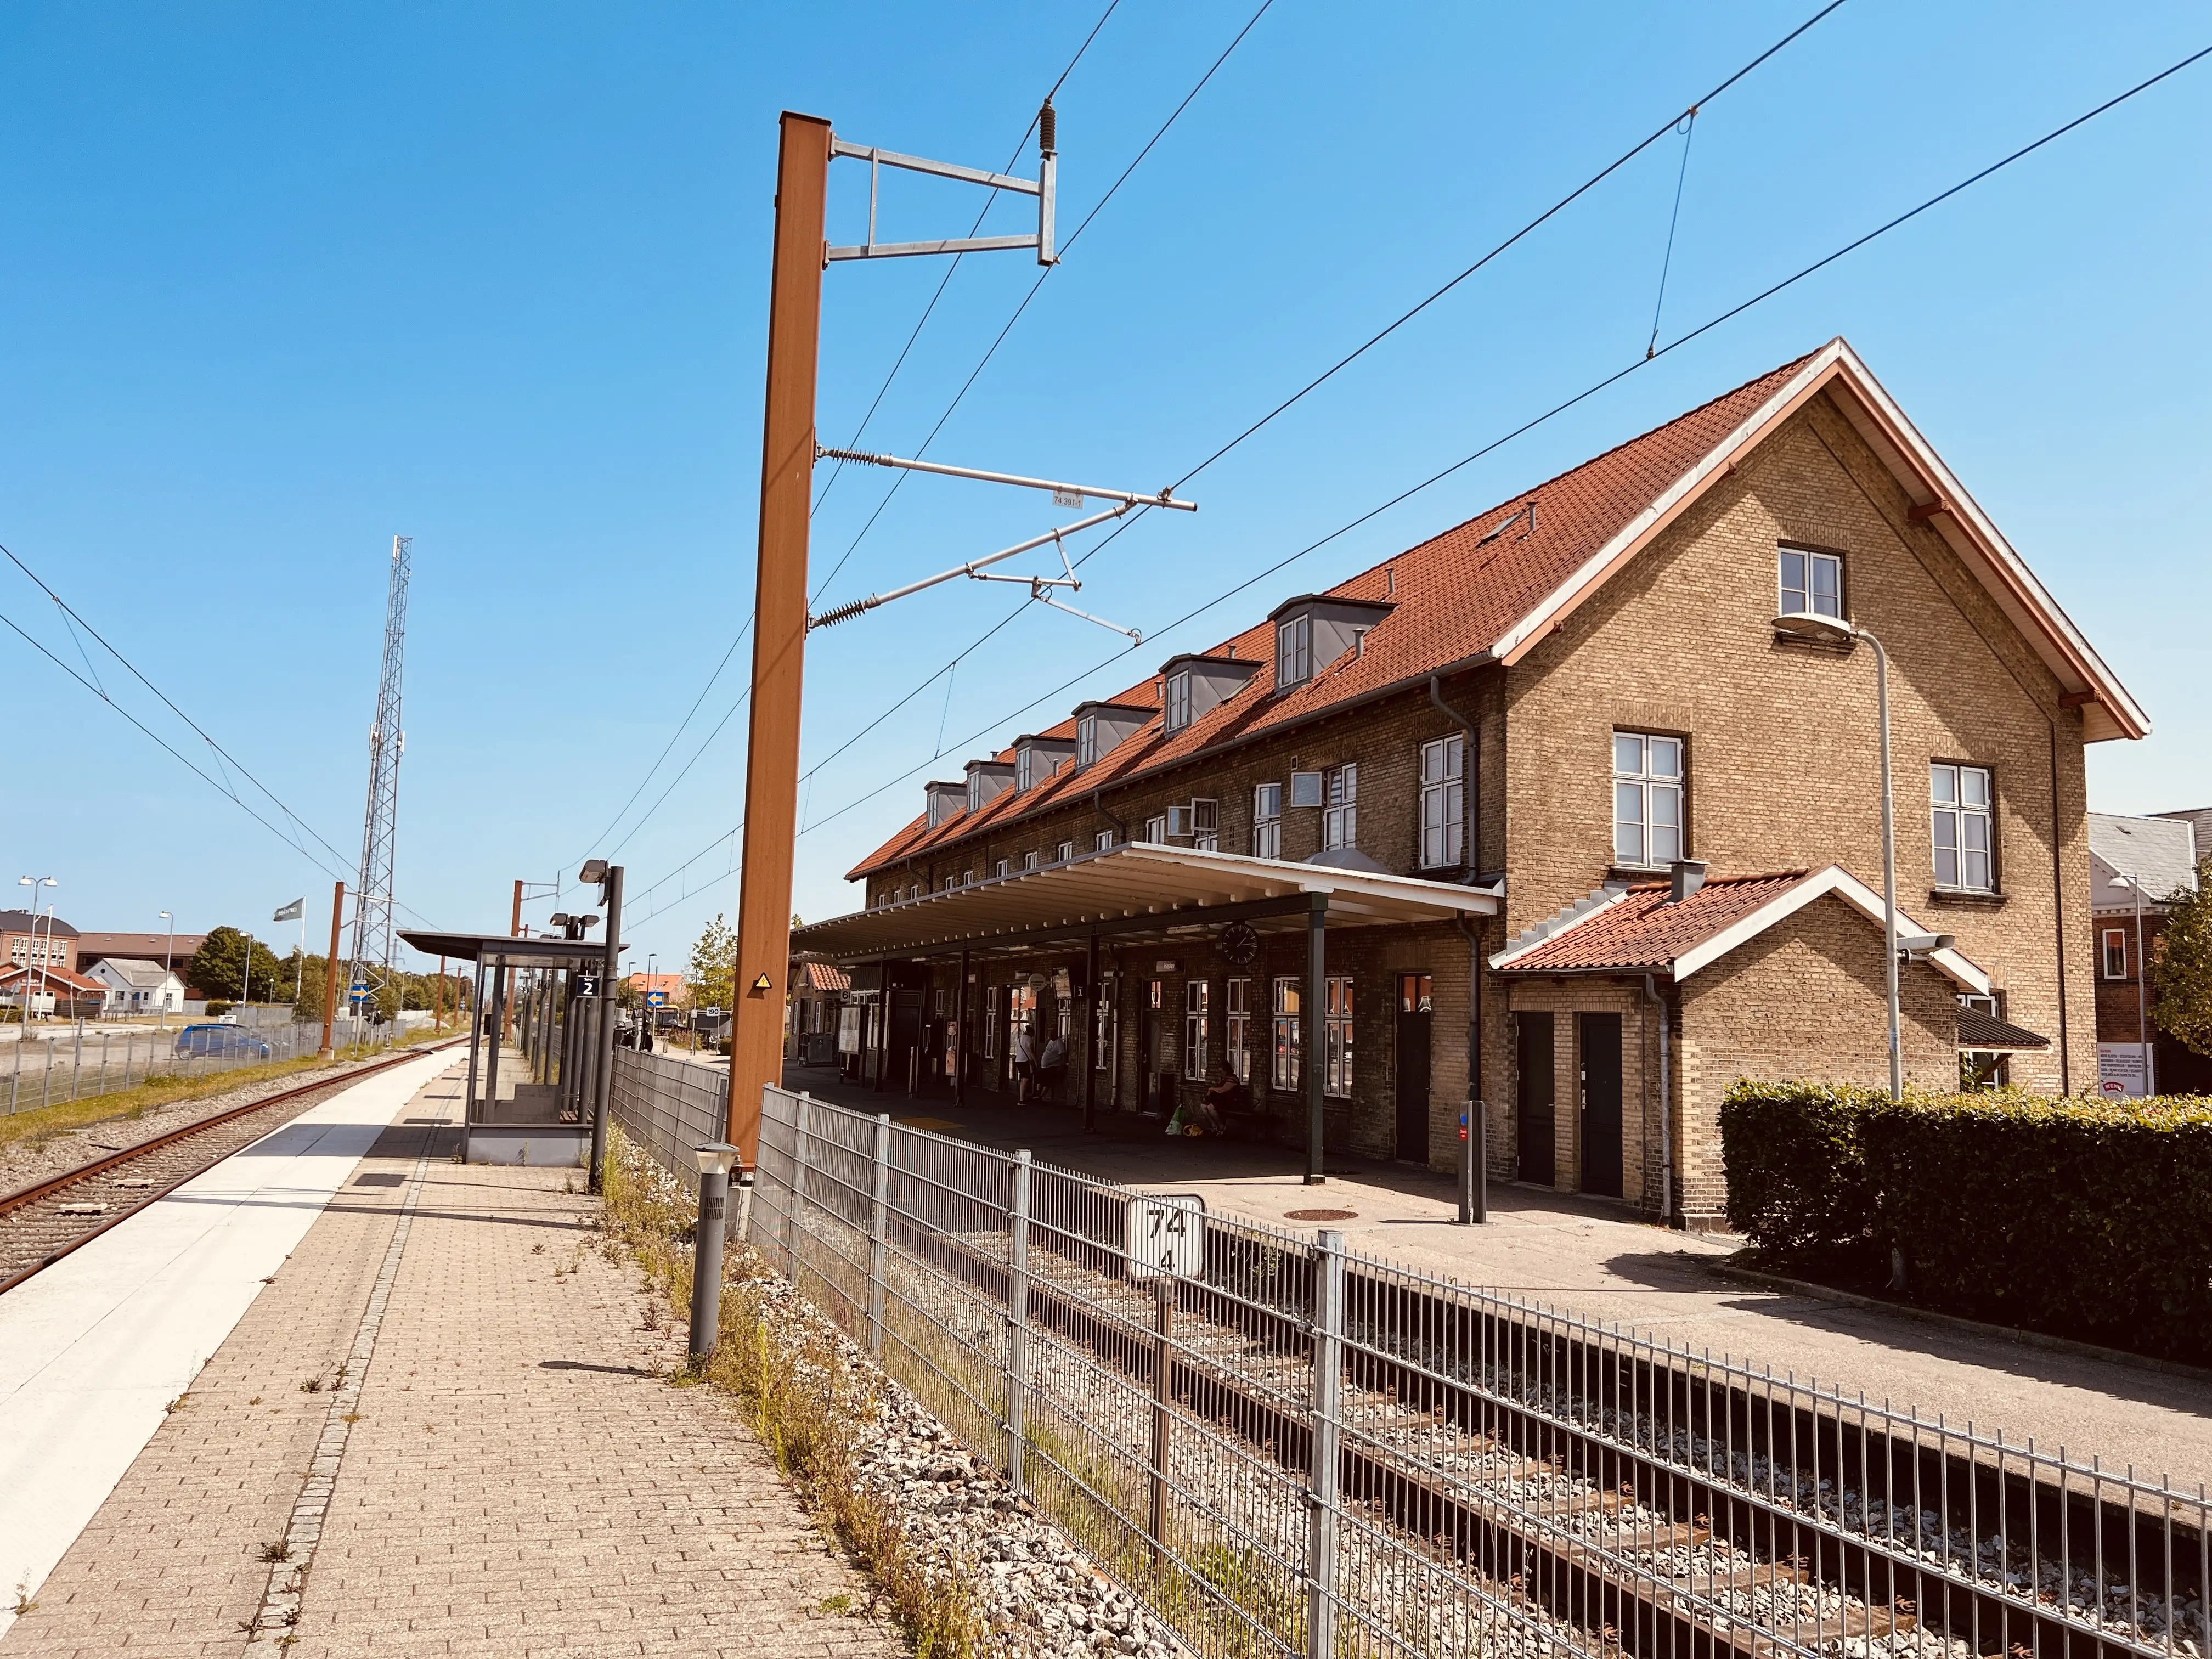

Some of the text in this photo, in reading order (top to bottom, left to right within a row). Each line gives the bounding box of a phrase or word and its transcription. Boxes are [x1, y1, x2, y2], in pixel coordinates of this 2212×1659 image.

[583, 983, 592, 995] 2
[842, 991, 851, 1000] 6
[1147, 1207, 1186, 1238] 74
[1161, 1250, 1175, 1272] 4
